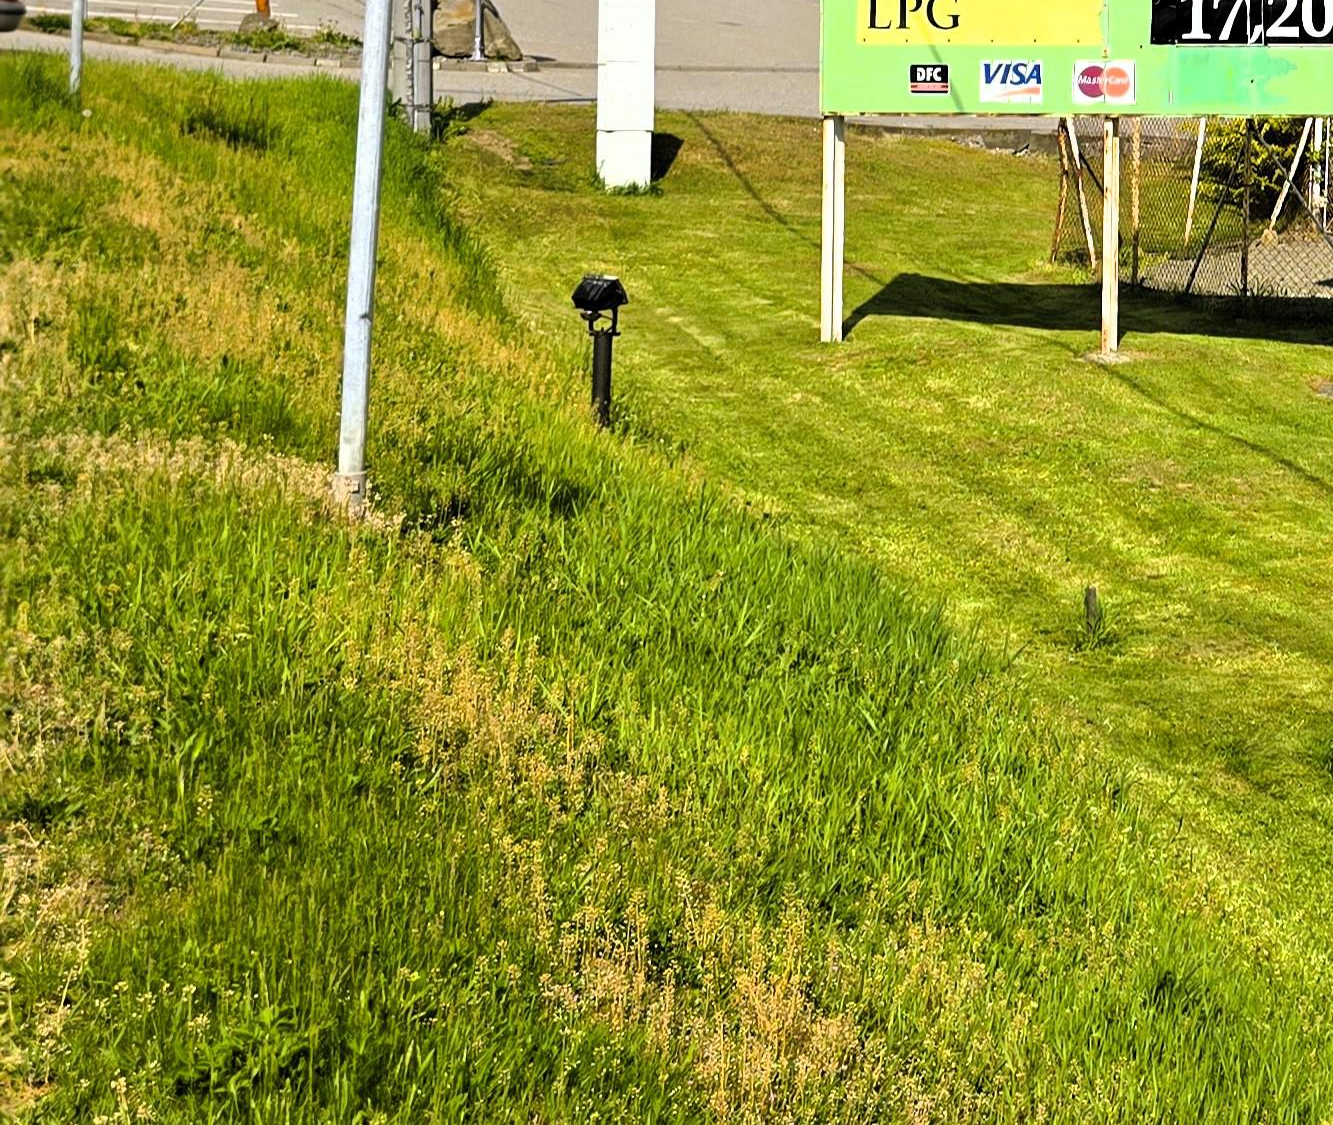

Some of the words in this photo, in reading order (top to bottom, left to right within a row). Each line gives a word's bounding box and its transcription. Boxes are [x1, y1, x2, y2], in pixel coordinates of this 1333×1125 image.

[916, 67, 942, 82] DFC
[983, 62, 1042, 85] VISA
[1077, 74, 1130, 85] MasterCard
